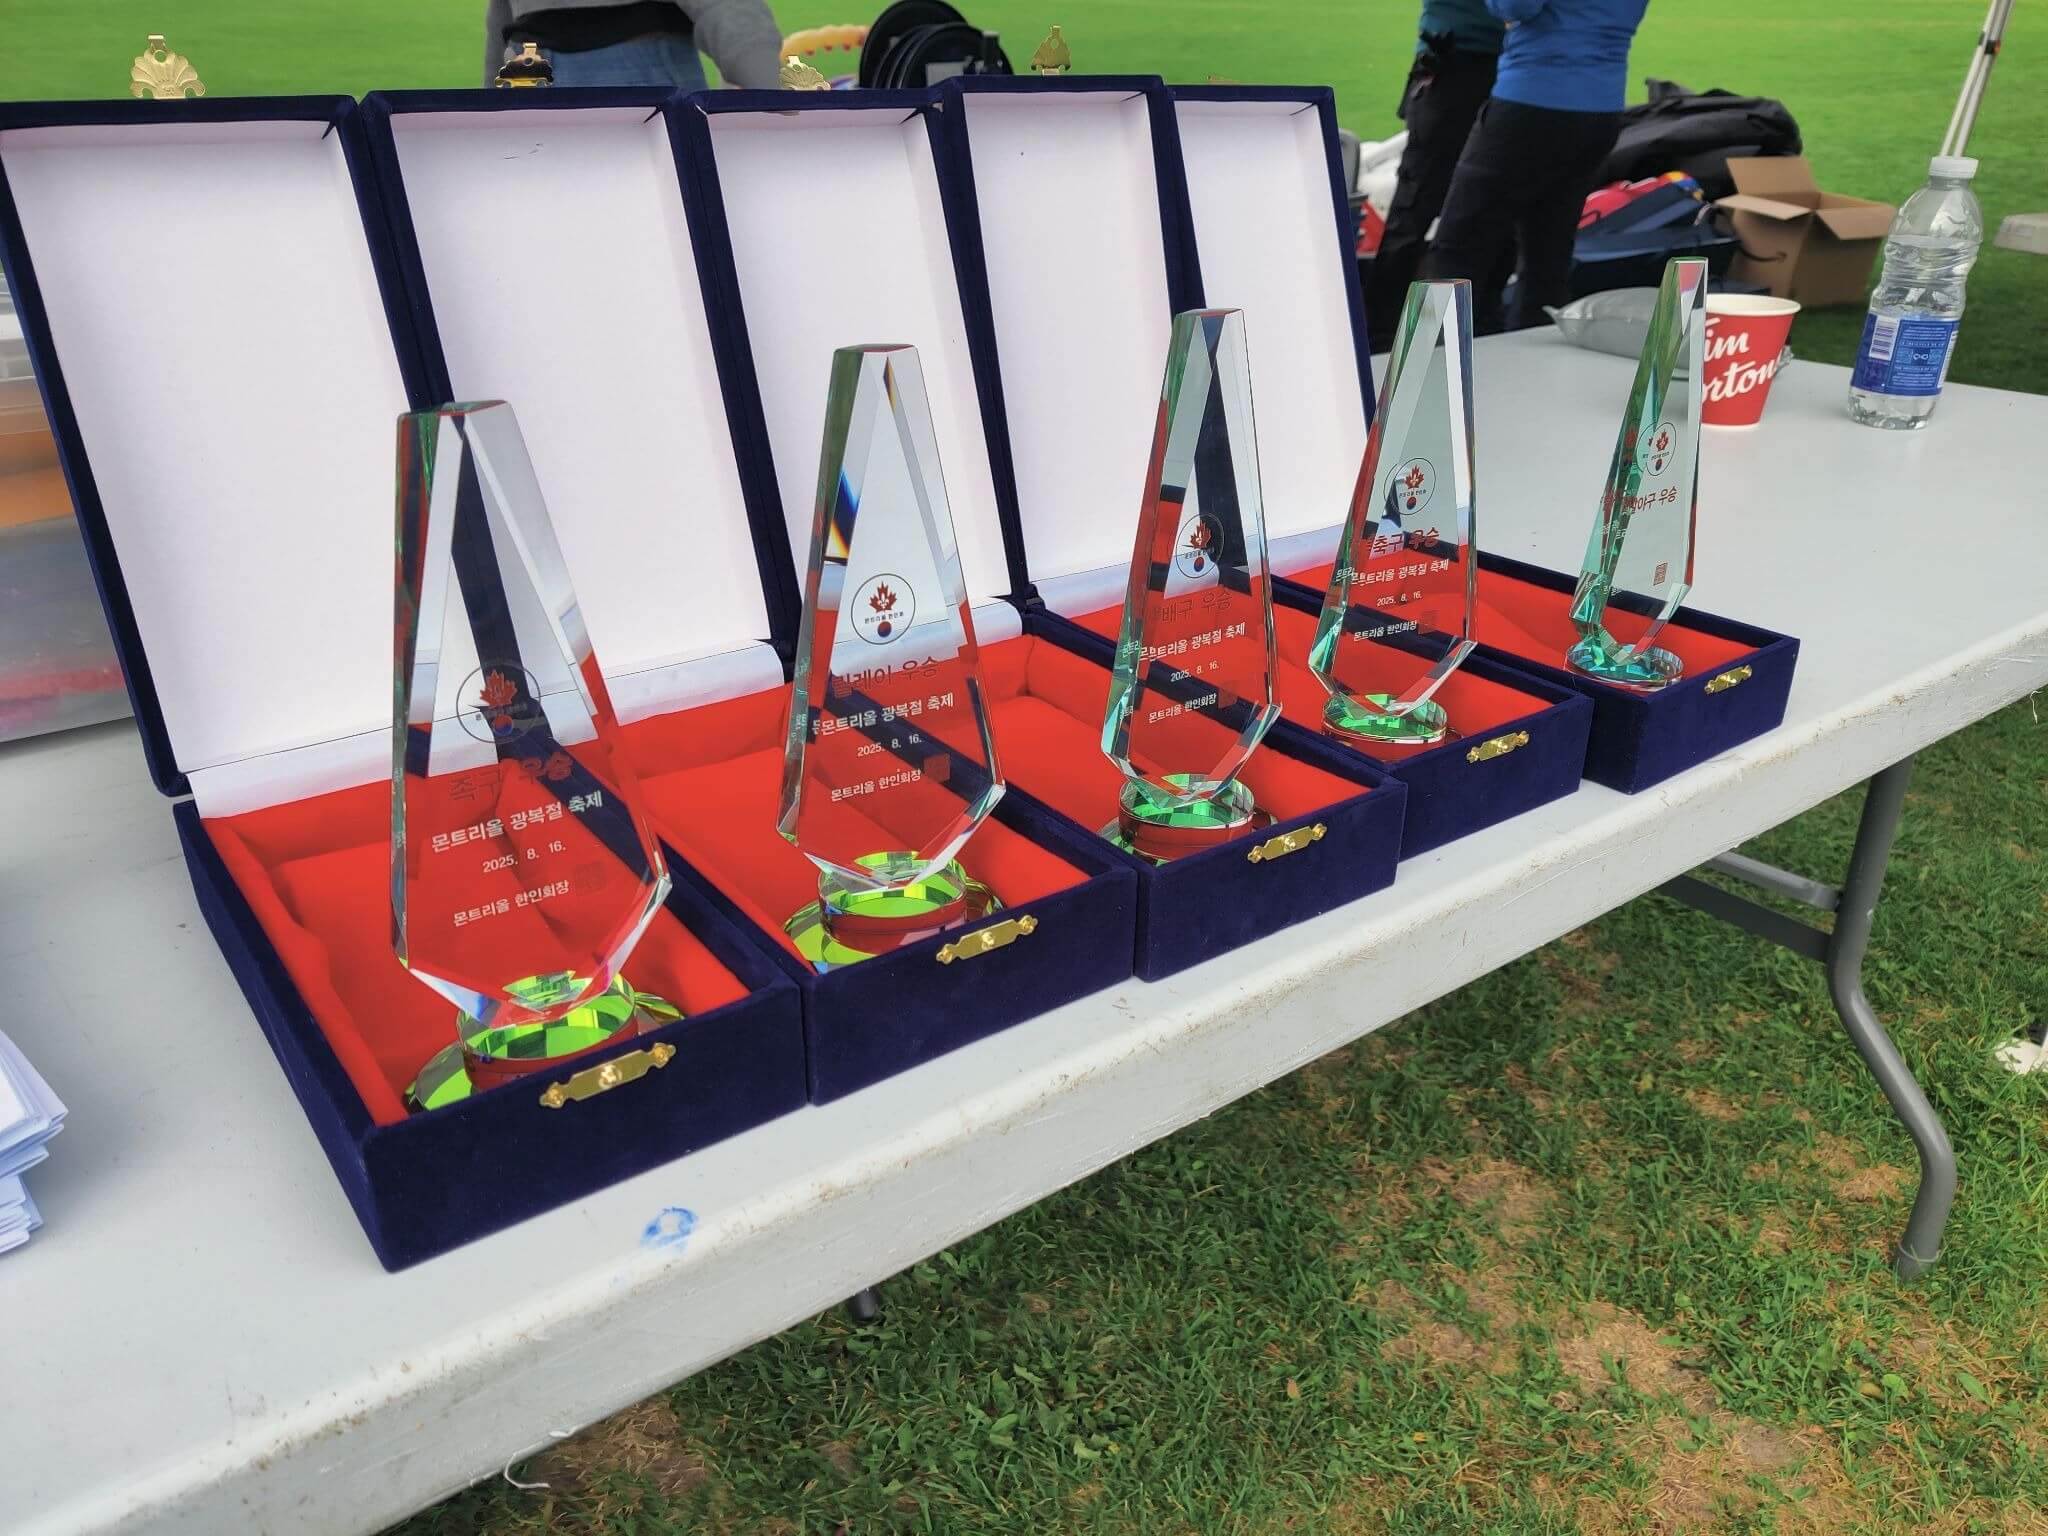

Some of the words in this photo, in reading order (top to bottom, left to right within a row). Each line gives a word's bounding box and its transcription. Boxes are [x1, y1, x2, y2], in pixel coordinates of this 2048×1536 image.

[1704, 317, 1750, 362] im
[1702, 349, 1783, 403] rton
[1658, 485, 1678, 507] 우승
[1372, 533, 1404, 554] 축구
[1408, 527, 1440, 549] 우승
[1398, 563, 1427, 580] 광복절
[1430, 558, 1450, 573] 축제
[1162, 599, 1193, 622] 배구
[1201, 589, 1233, 616] 우승
[1376, 595, 1397, 607] 2025.
[1412, 590, 1422, 600] 16.
[1191, 628, 1222, 650] 광복절
[1225, 621, 1246, 639] 축제
[1353, 626, 1385, 642] 몬트리올
[1386, 619, 1418, 635] 한인회장
[901, 656, 939, 681] 우승
[1170, 668, 1192, 682] 2025.
[1208, 660, 1220, 671] 16.
[821, 709, 878, 736] 몬트리올
[881, 699, 923, 722] 광복절
[927, 692, 954, 711] 축제
[1148, 703, 1182, 723] 몬트리올
[1184, 692, 1217, 712] 한인회장
[857, 743, 886, 757] 2025.
[891, 738, 902, 749] 8.
[908, 733, 922, 745] 16.
[831, 780, 876, 802] 몬트리올
[878, 769, 922, 790] 한인회장
[431, 818, 504, 853] 몬트리올
[509, 801, 563, 831] 광복절
[568, 790, 604, 813] 축제
[482, 854, 518, 873] 2025.
[526, 847, 540, 861] 8.
[548, 840, 566, 854] 16.
[453, 898, 510, 927] 몬트리올
[515, 879, 570, 907] 한인회장
